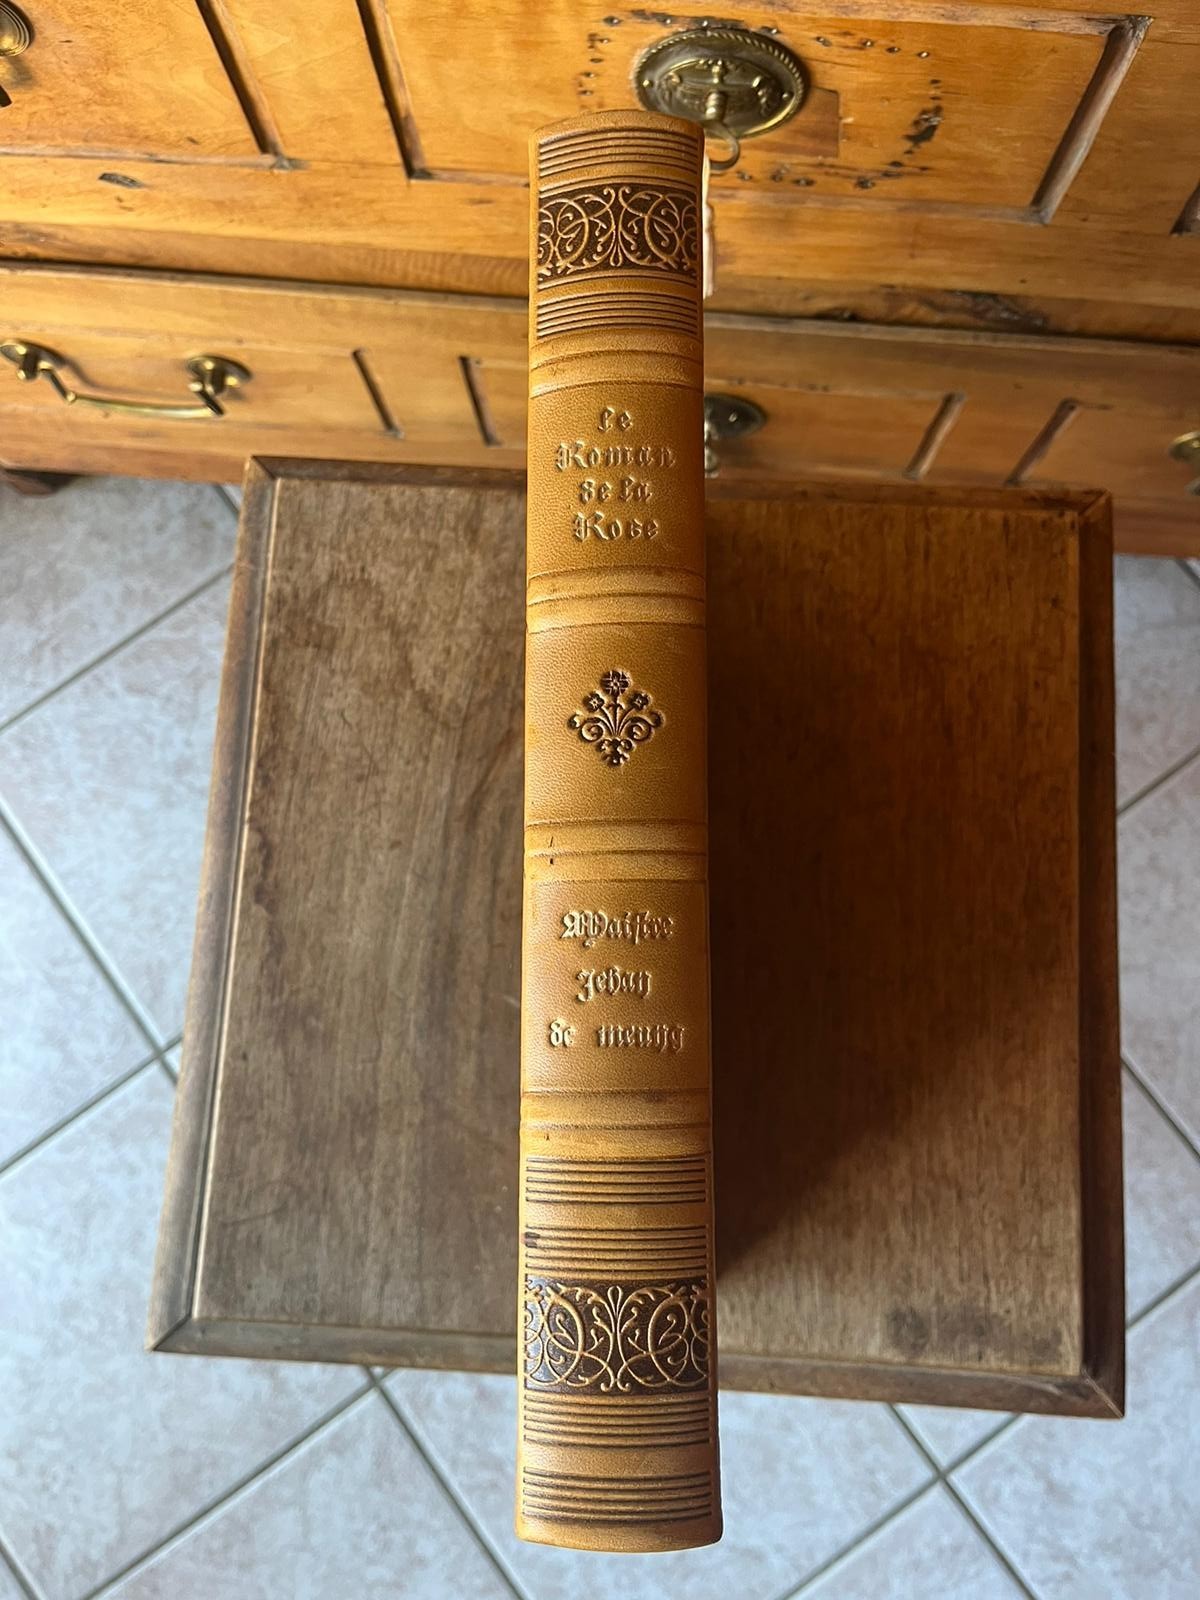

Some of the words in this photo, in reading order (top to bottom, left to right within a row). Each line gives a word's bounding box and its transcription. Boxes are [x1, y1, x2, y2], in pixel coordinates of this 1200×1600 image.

[556, 440, 676, 472] Roman
[579, 478, 612, 503] de
[573, 511, 659, 542] Rose
[560, 910, 674, 948] Maistre
[576, 965, 652, 1002] Jehan
[550, 1016, 576, 1047] de
